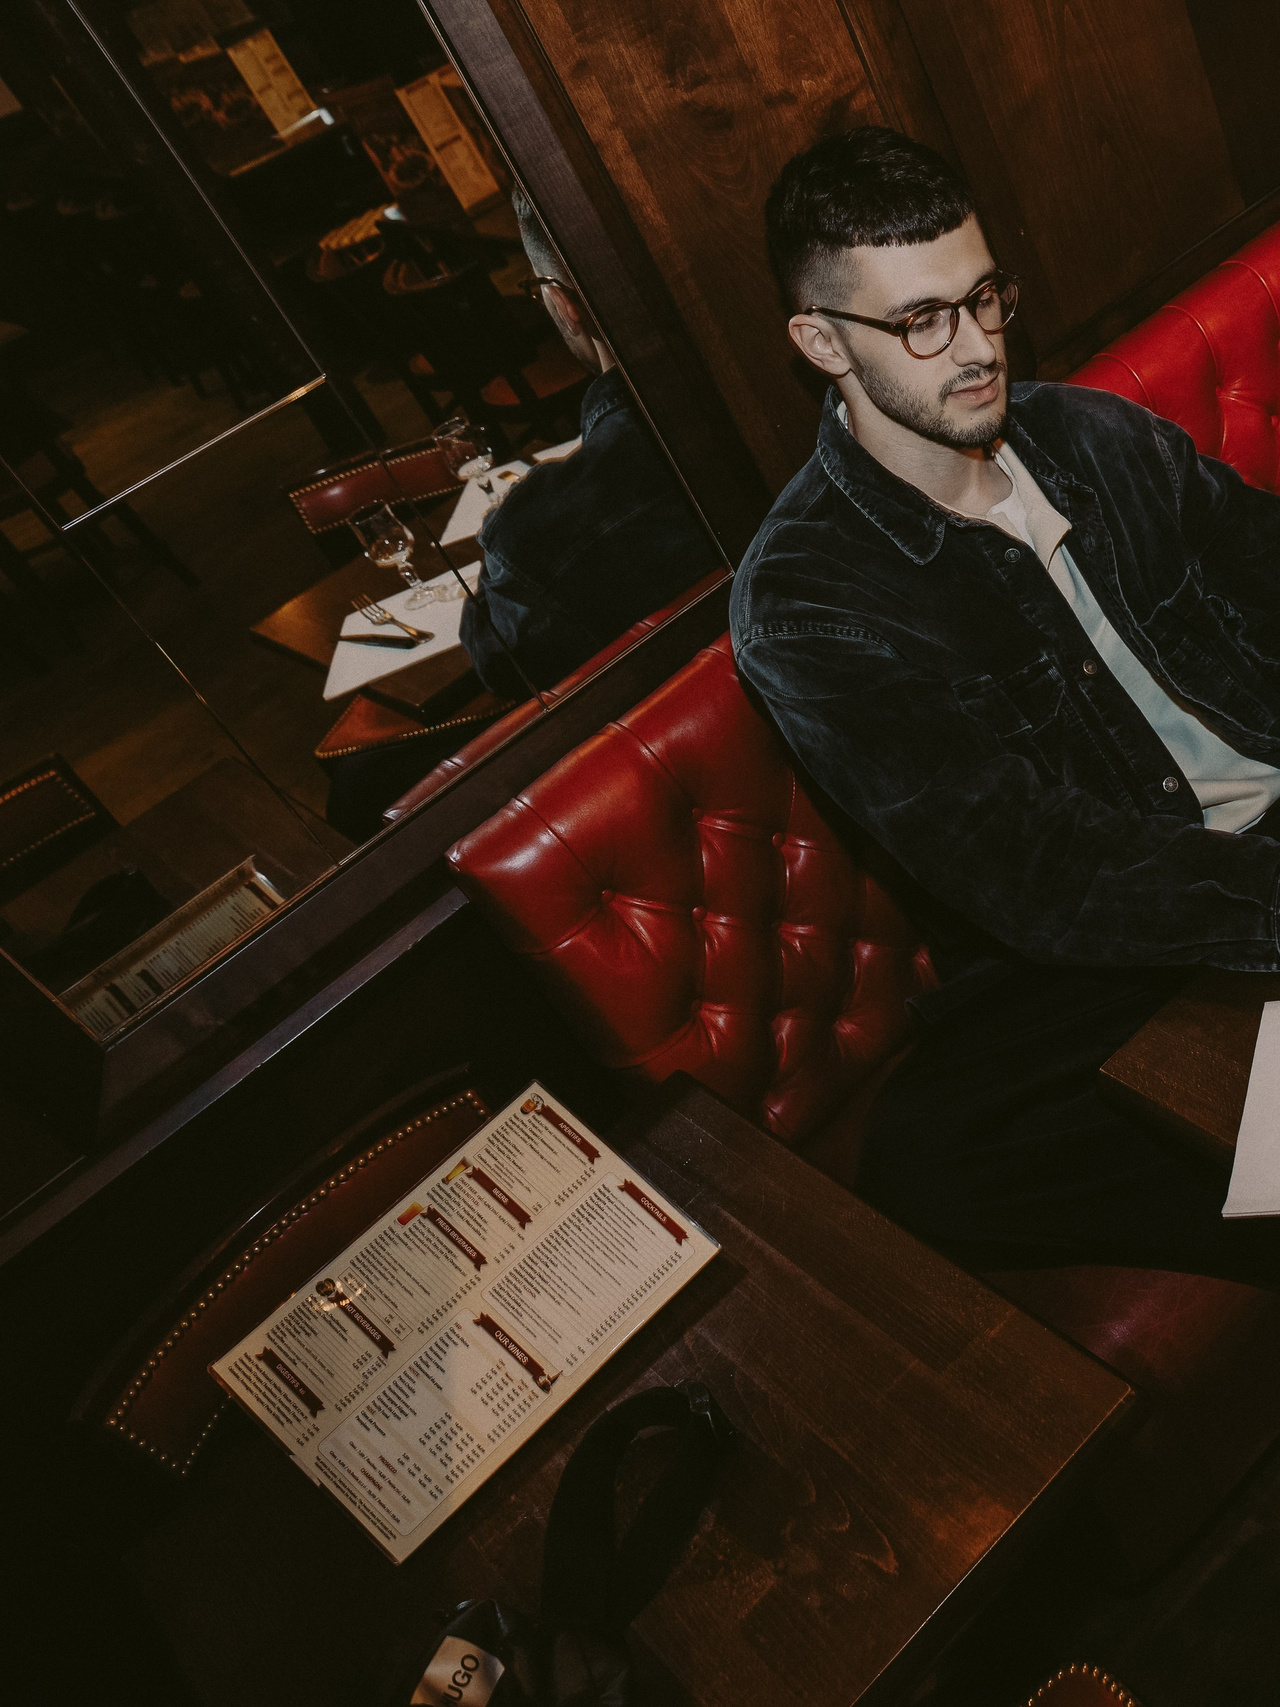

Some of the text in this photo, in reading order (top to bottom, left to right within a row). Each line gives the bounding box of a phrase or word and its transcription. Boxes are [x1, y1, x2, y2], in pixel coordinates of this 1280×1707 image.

[491, 1187, 509, 1203] BEERS
[639, 1196, 667, 1221] COCKTAILS
[435, 1217, 477, 1257] FRESH BEVERAGES
[344, 1303, 355, 1314] HOT
[353, 1312, 381, 1340] BEVERAGES
[493, 1329, 529, 1363] OUR WINES
[275, 1363, 300, 1388] DIGESTIFS
